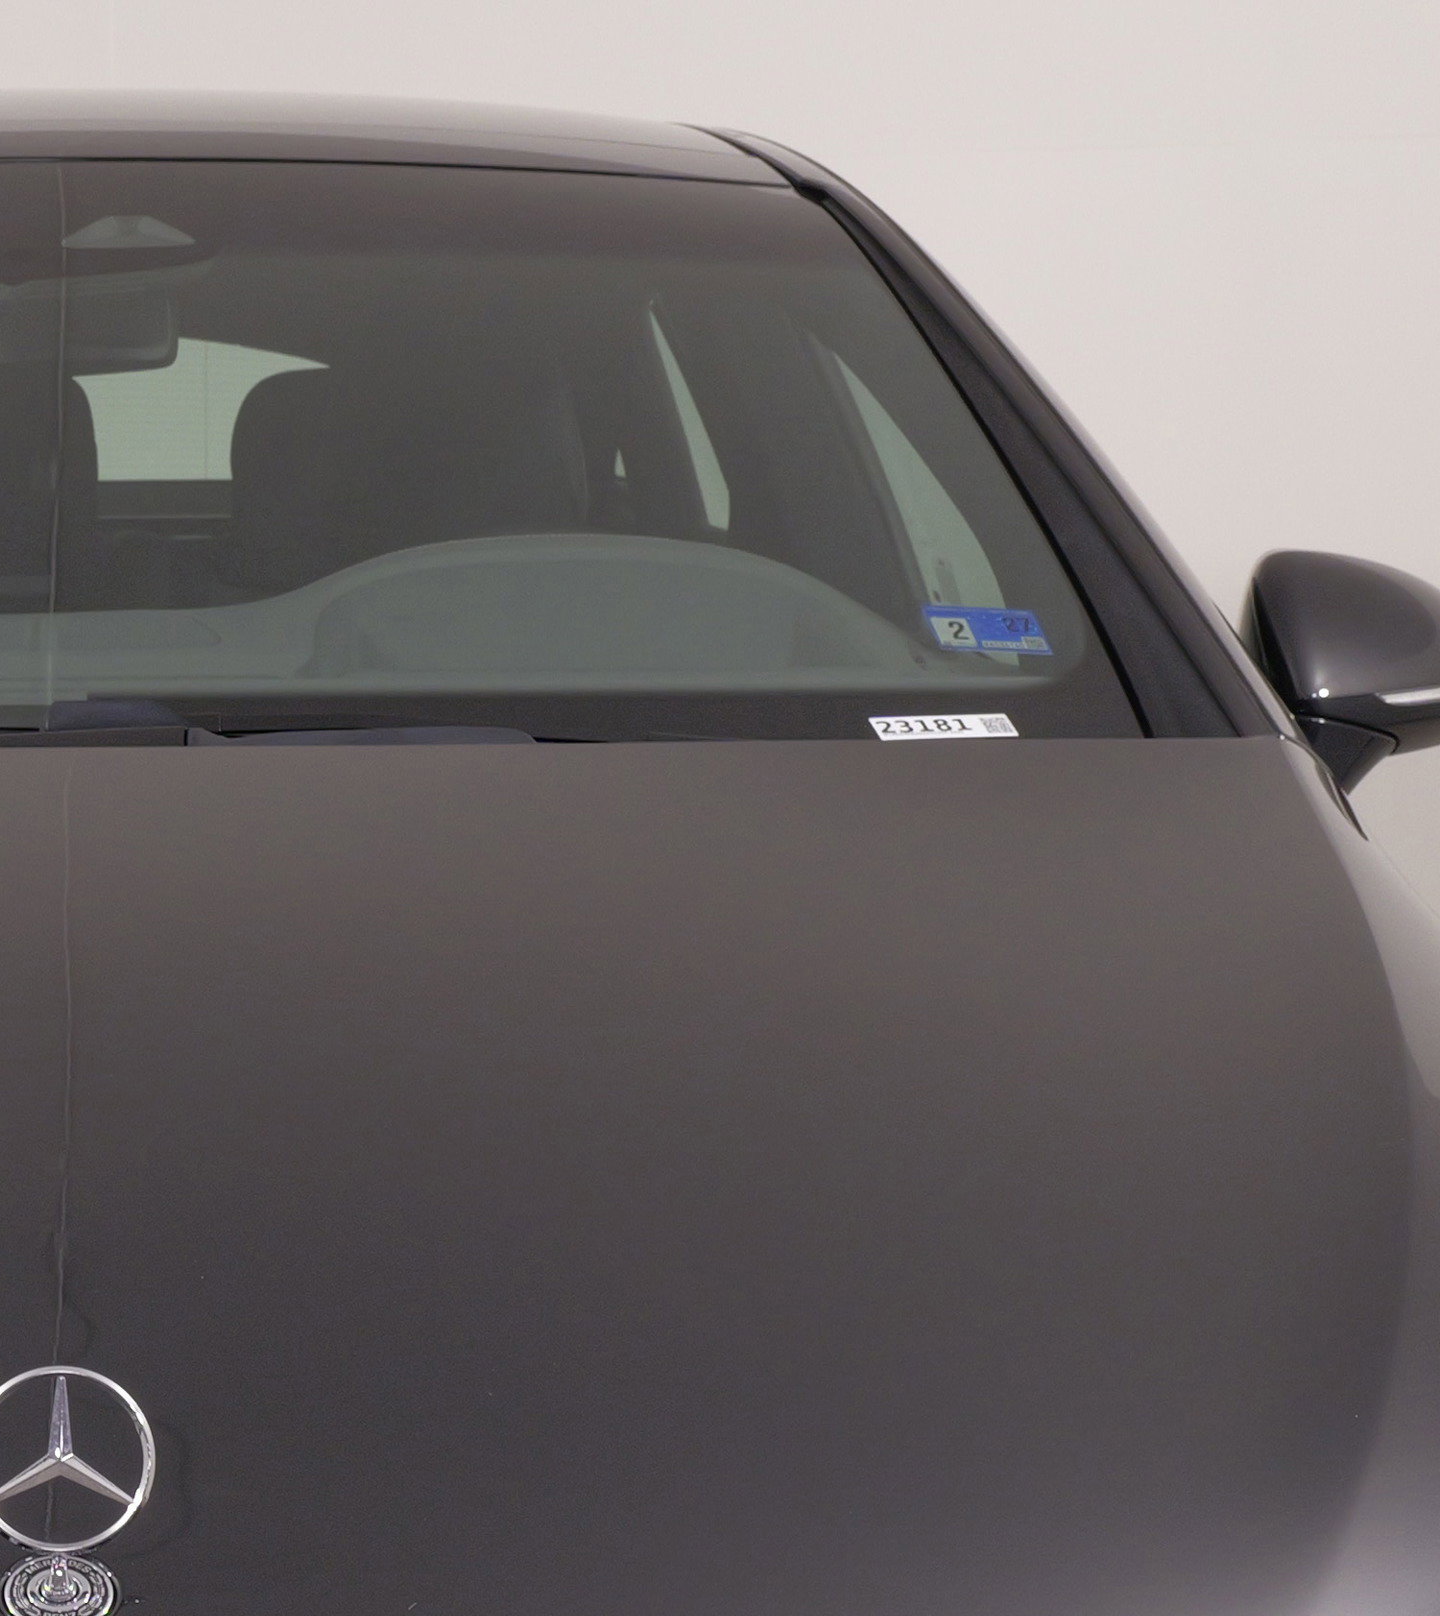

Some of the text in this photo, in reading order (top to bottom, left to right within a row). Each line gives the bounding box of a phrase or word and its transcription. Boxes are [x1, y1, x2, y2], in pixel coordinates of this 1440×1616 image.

[948, 621, 969, 640] 2
[1001, 617, 1030, 633] 27
[876, 718, 972, 733] 23181
